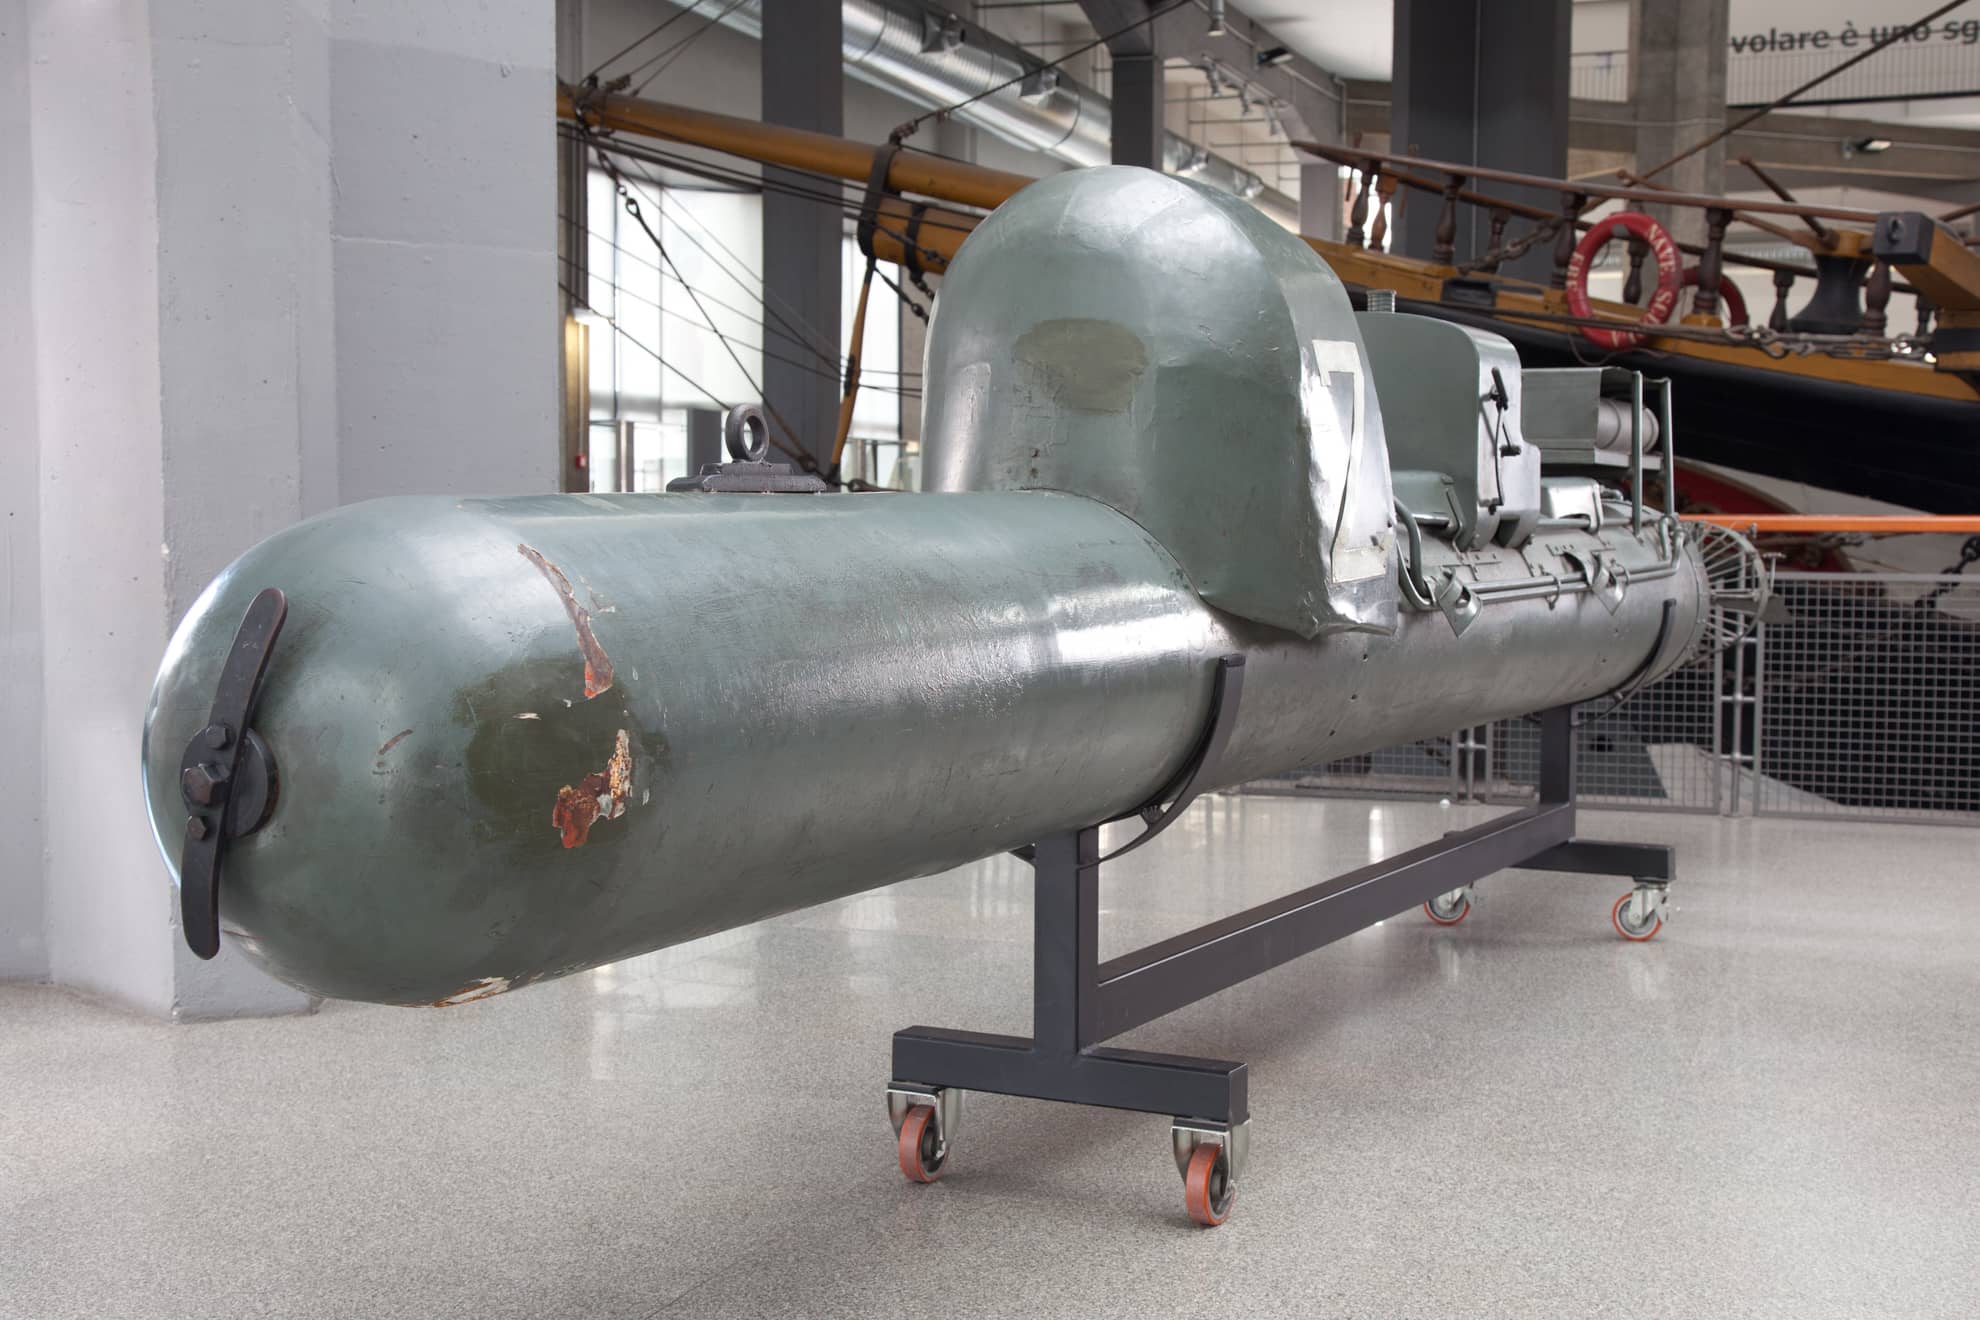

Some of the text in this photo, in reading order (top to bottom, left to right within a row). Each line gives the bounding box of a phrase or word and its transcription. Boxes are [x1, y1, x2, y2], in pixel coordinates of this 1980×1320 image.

[1731, 28, 1829, 53] volare
[1840, 20, 1858, 47] è
[1871, 22, 1931, 48] uno
[1649, 223, 1676, 272] NAVE
